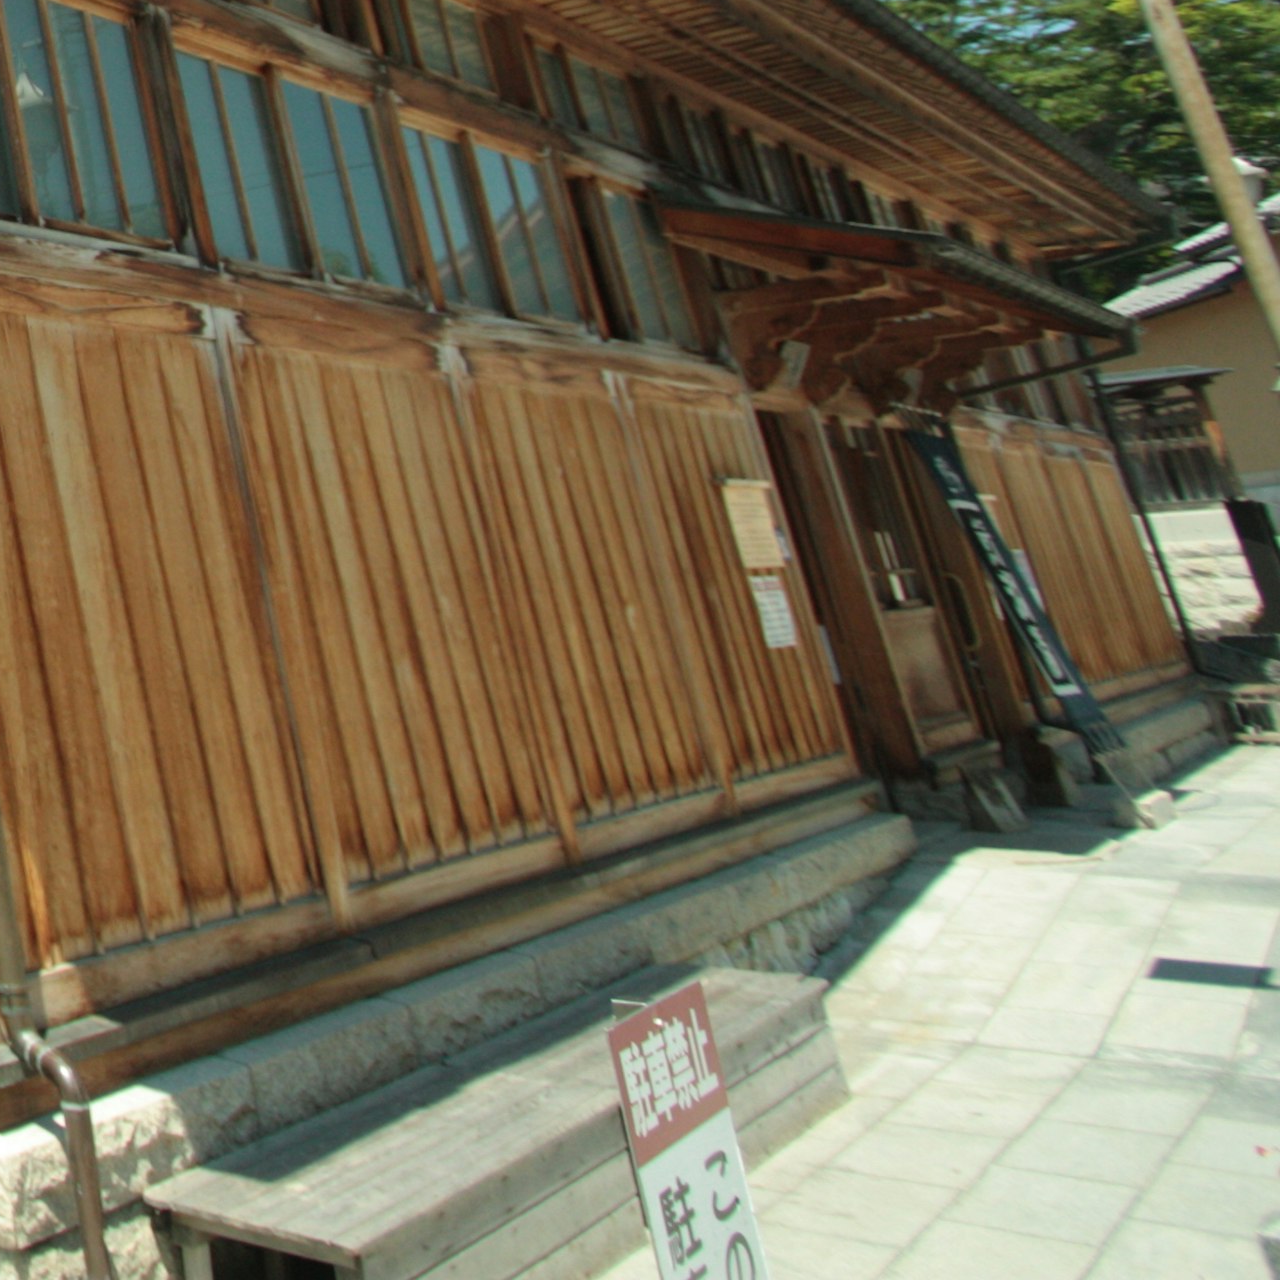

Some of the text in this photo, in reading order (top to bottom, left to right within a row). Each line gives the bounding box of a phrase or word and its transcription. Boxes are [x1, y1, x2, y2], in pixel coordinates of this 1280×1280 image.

[618, 1007, 719, 1138] 駐車禁止
[659, 1176, 708, 1280] 駐
